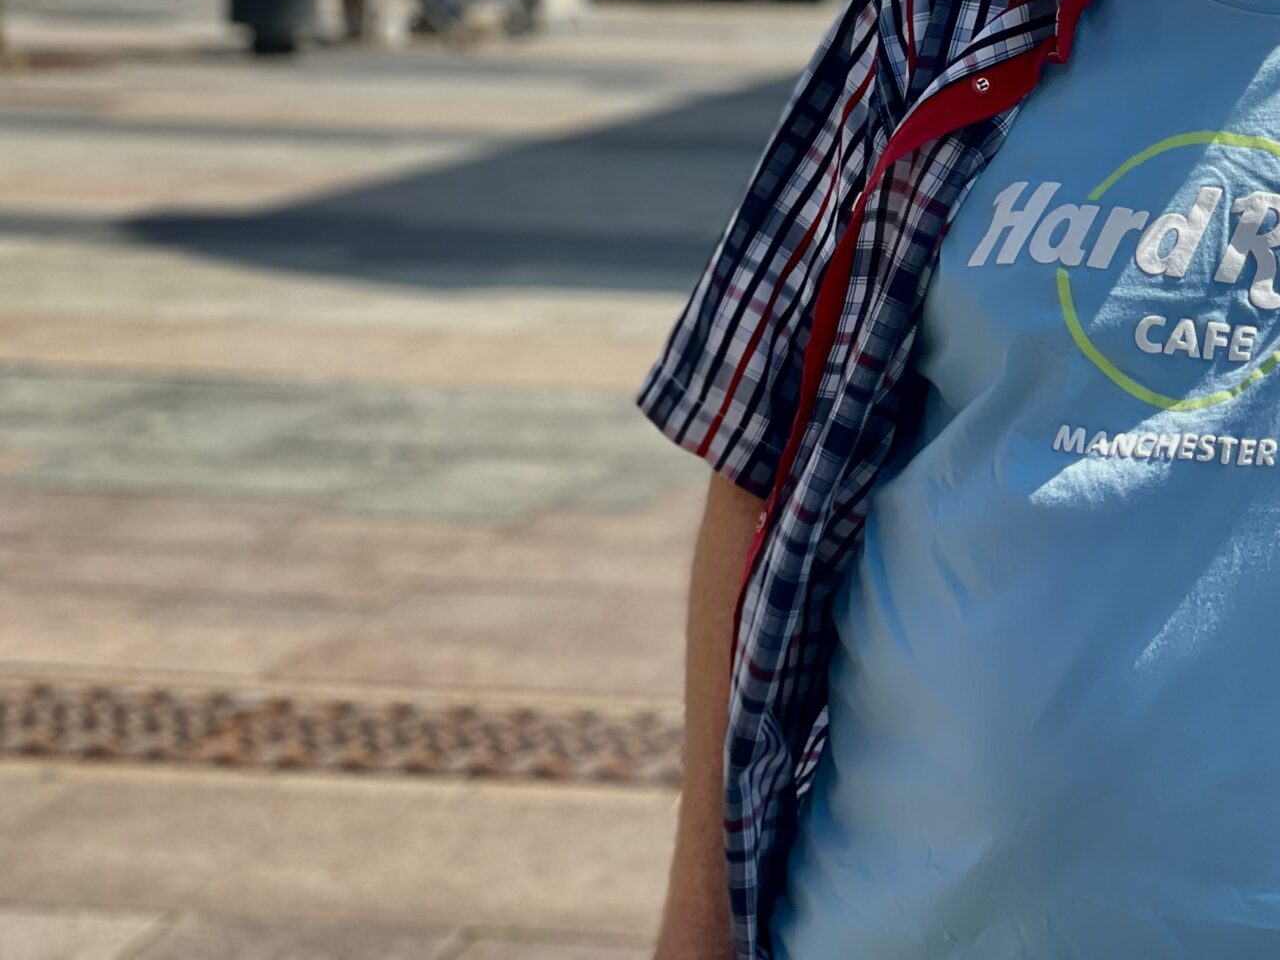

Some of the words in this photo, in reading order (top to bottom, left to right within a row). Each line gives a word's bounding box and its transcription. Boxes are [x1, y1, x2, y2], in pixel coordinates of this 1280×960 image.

[967, 181, 1222, 278] Hard
[1134, 315, 1257, 362] CAFE
[1053, 424, 1278, 466] MANCHESTER
